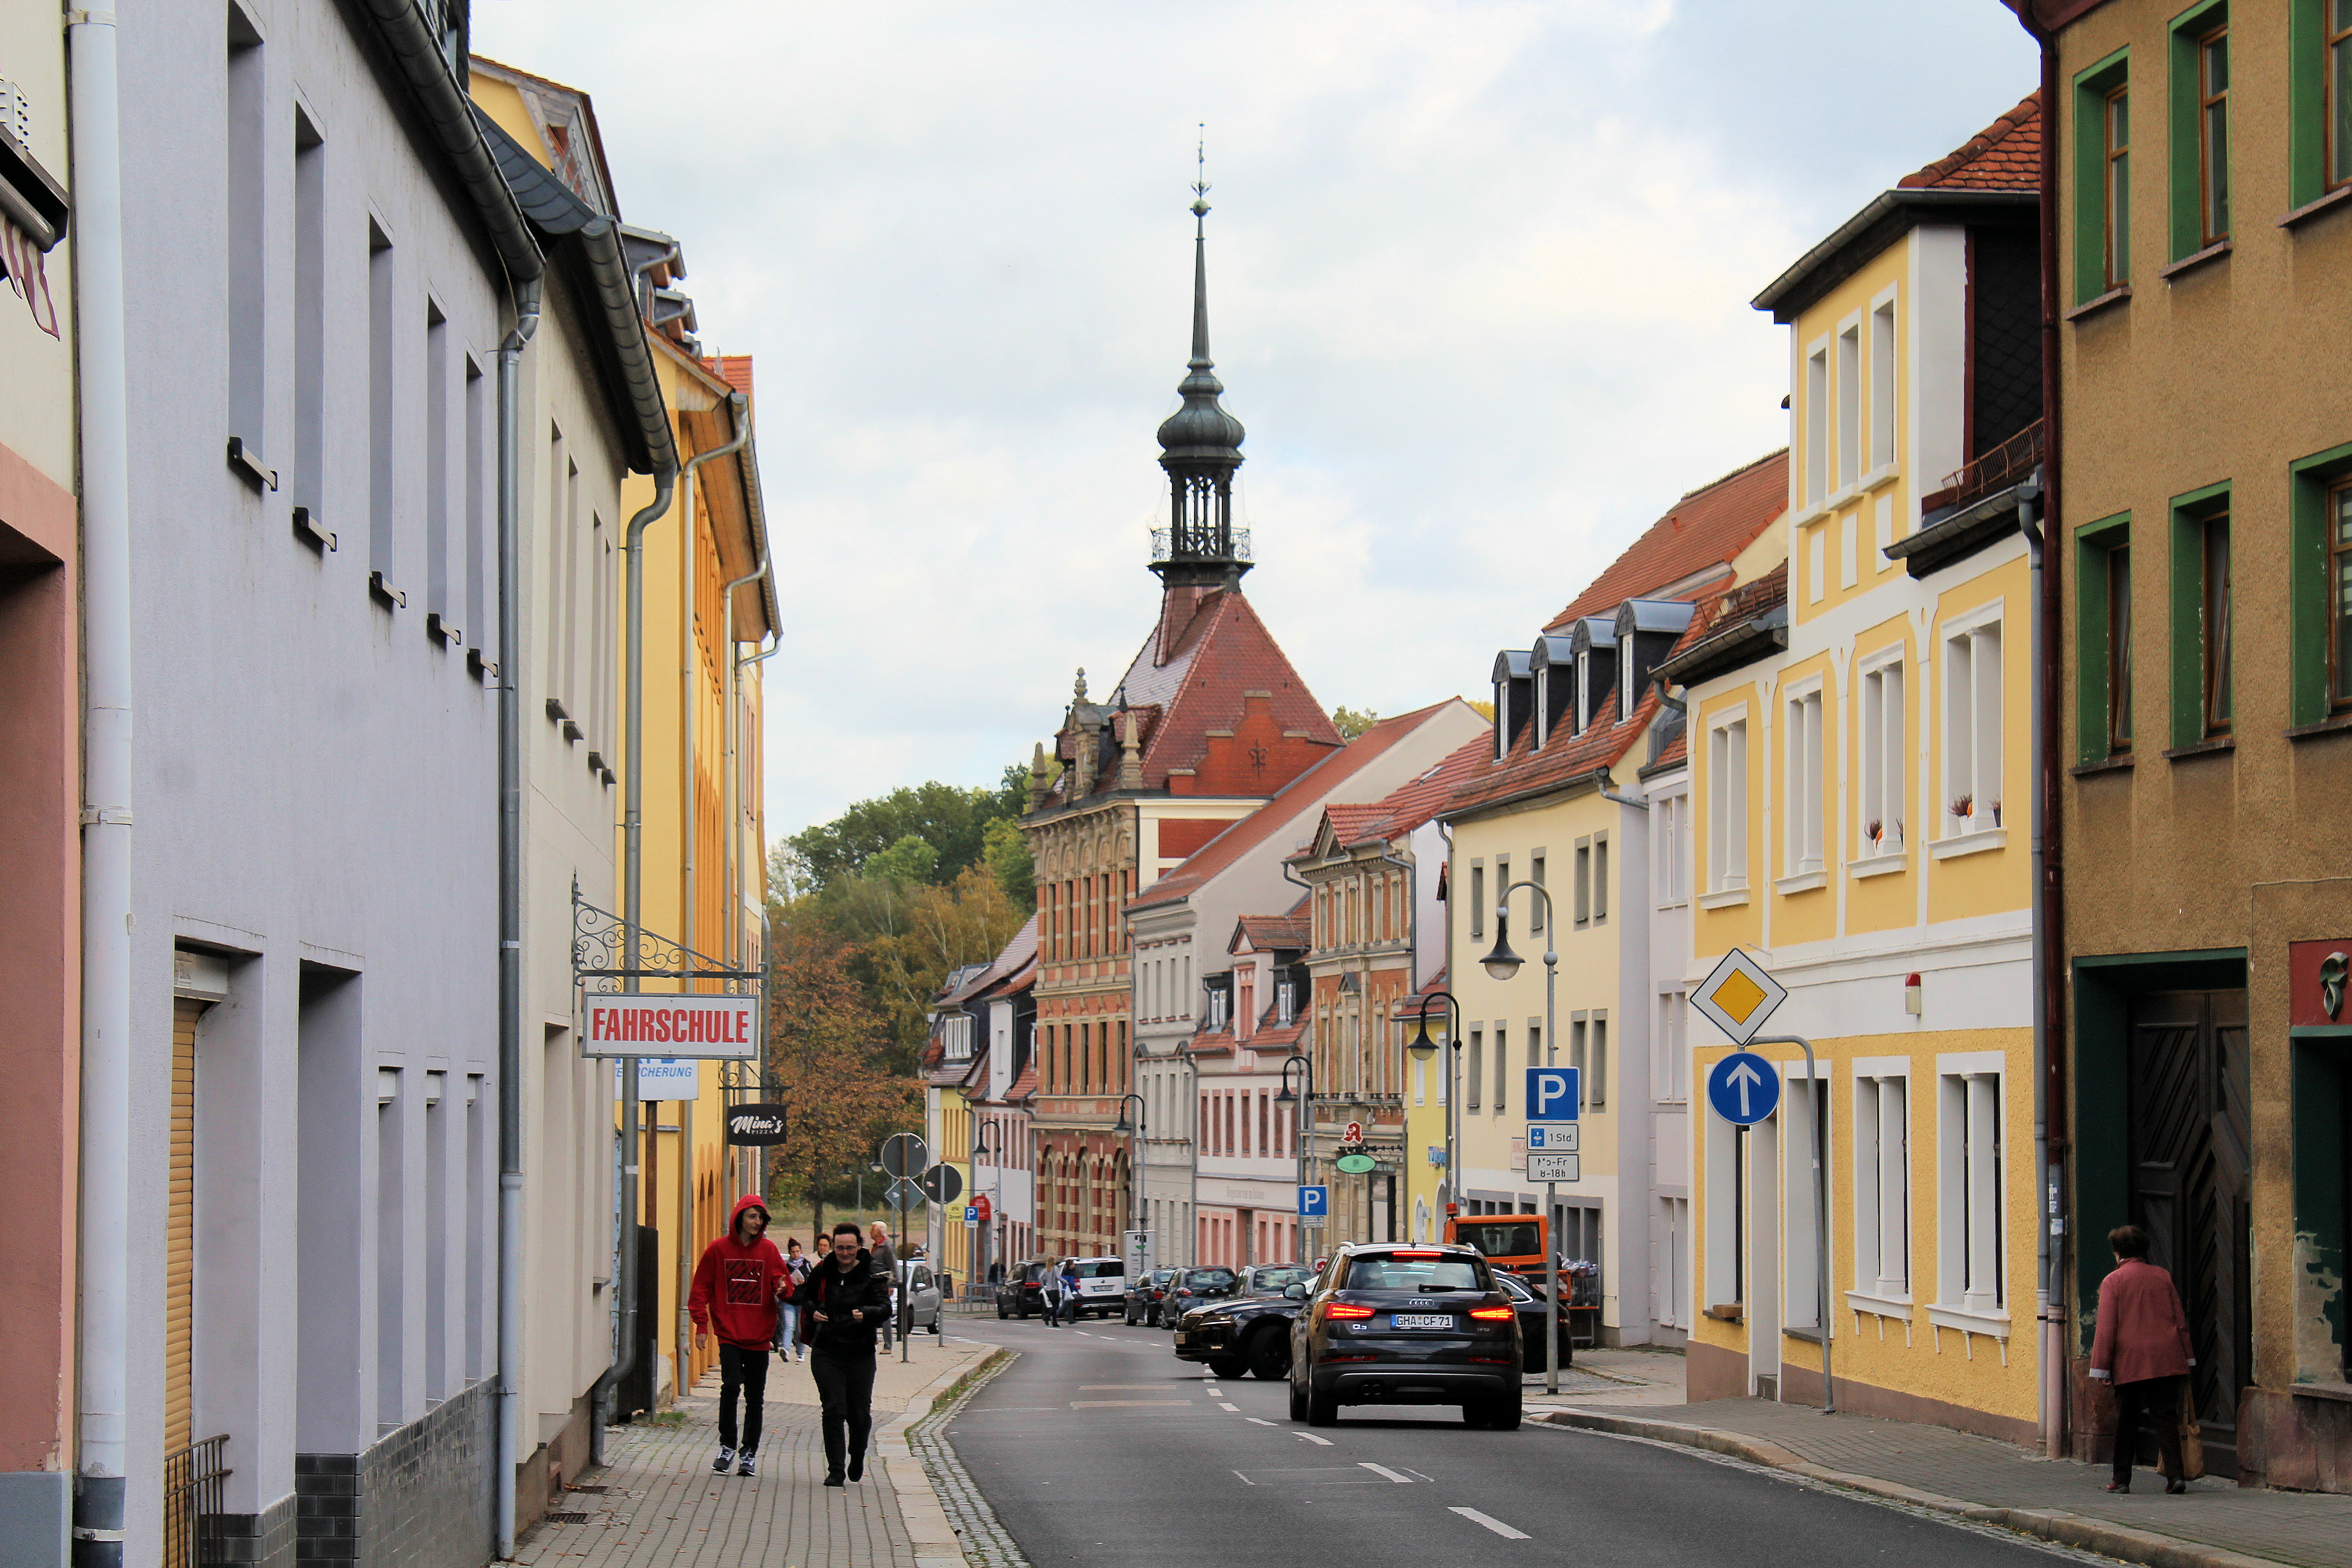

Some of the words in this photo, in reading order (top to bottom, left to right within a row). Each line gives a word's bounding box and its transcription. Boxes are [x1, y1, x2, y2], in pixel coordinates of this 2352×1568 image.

[593, 1008, 749, 1043] FAHRSCHULE
[1539, 1074, 1566, 1114] P
[1556, 1134, 1574, 1142] Std.
[1540, 1169, 1565, 1177] 8-18h
[1305, 1190, 1320, 1212] P
[967, 1208, 975, 1219] P
[1397, 1316, 1416, 1325] GHA
[1424, 1317, 1436, 1325] CF
[1439, 1317, 1450, 1326] 71
